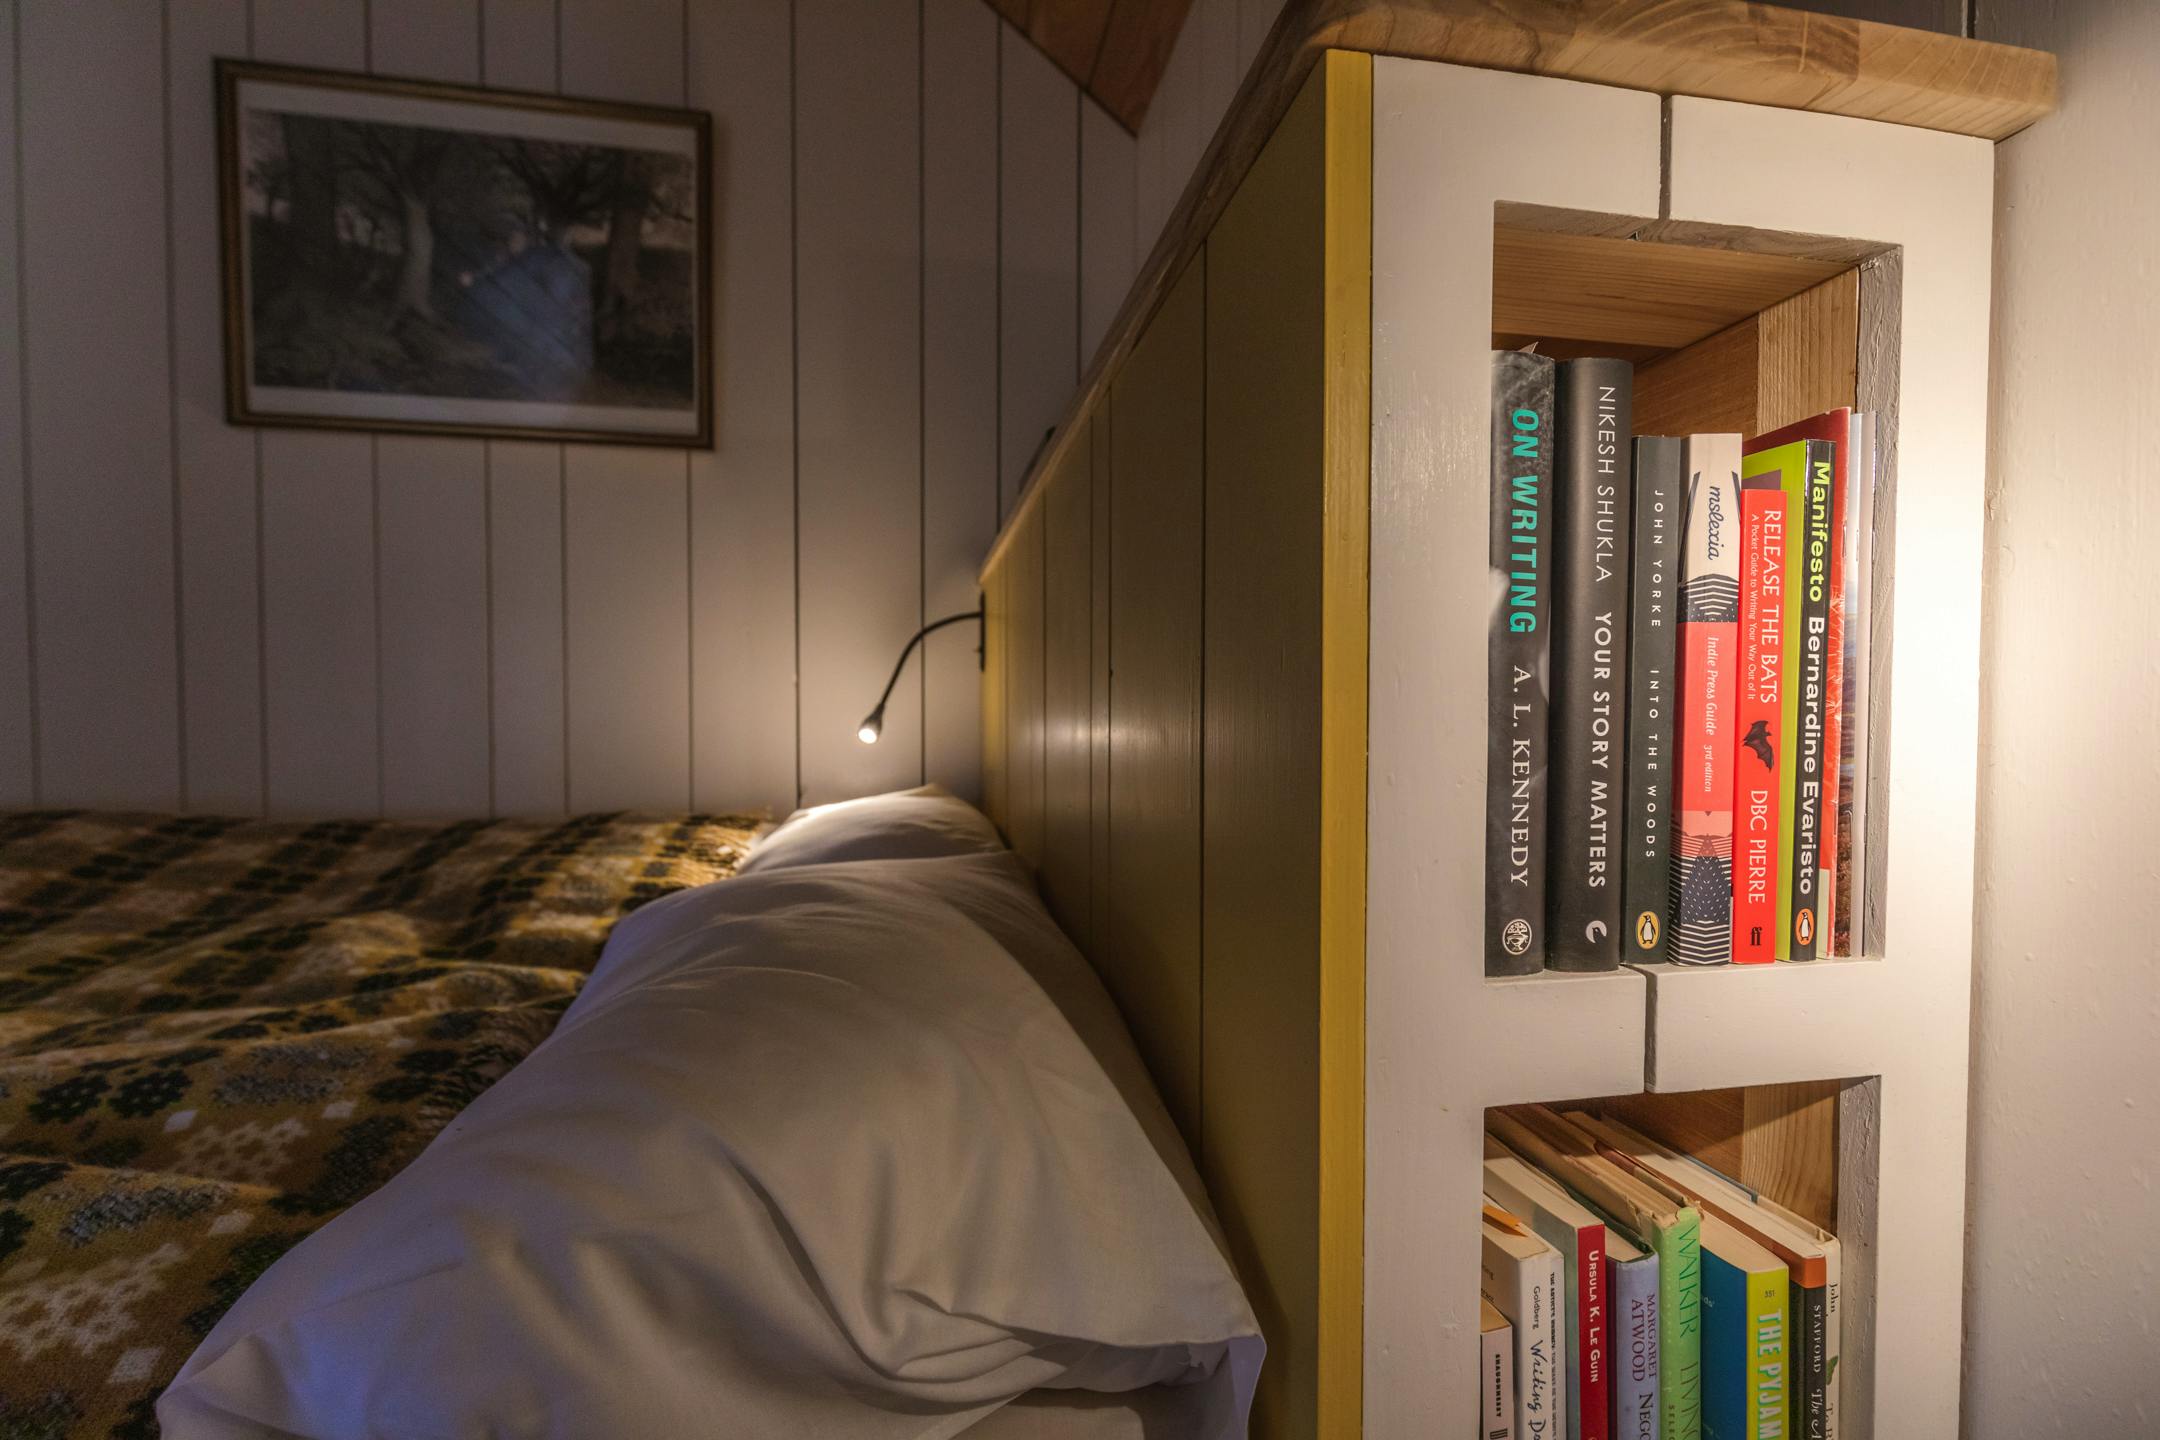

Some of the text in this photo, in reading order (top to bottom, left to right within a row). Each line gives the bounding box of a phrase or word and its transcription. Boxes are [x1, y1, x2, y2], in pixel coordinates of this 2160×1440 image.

[1509, 408, 1540, 633] ON WRITING
[1595, 386, 1616, 582] NIKESH SHUKLA
[1751, 513, 1760, 522] A
[1651, 490, 1664, 627] JOHN YORKE
[1708, 485, 1725, 561] mslexia
[1751, 524, 1760, 550] Pocket
[1809, 461, 1831, 602] Manifesto
[1750, 552, 1760, 576] Guide
[1750, 578, 1759, 588] to
[1748, 590, 1759, 620] Writing
[1749, 622, 1758, 641] Your
[1760, 509, 1783, 704] RELEASE THE BATS
[1747, 644, 1757, 662] Way
[1747, 682, 1756, 692] of
[1748, 664, 1757, 680] Out
[1588, 612, 1612, 888] YOUR STORY MATTERS
[1703, 636, 1720, 793] Indie Press Guide 3rd edition
[1510, 665, 1532, 887] A. L. KENNEDY
[1645, 670, 1659, 858] INTO THE WOODS
[1800, 616, 1825, 895] Bernardine Evaristo
[1748, 790, 1768, 904] DBC PIERRE
[1532, 1285, 1541, 1330] Goldberg
[1589, 1306, 1600, 1322] K.
[1631, 1299, 1646, 1382] ATWOOD
[1647, 1293, 1657, 1377] MARGARET
[1757, 1308, 1782, 1358] THE
[1813, 1304, 1822, 1373] STAFFORD
[1527, 1339, 1548, 1413] Writing
